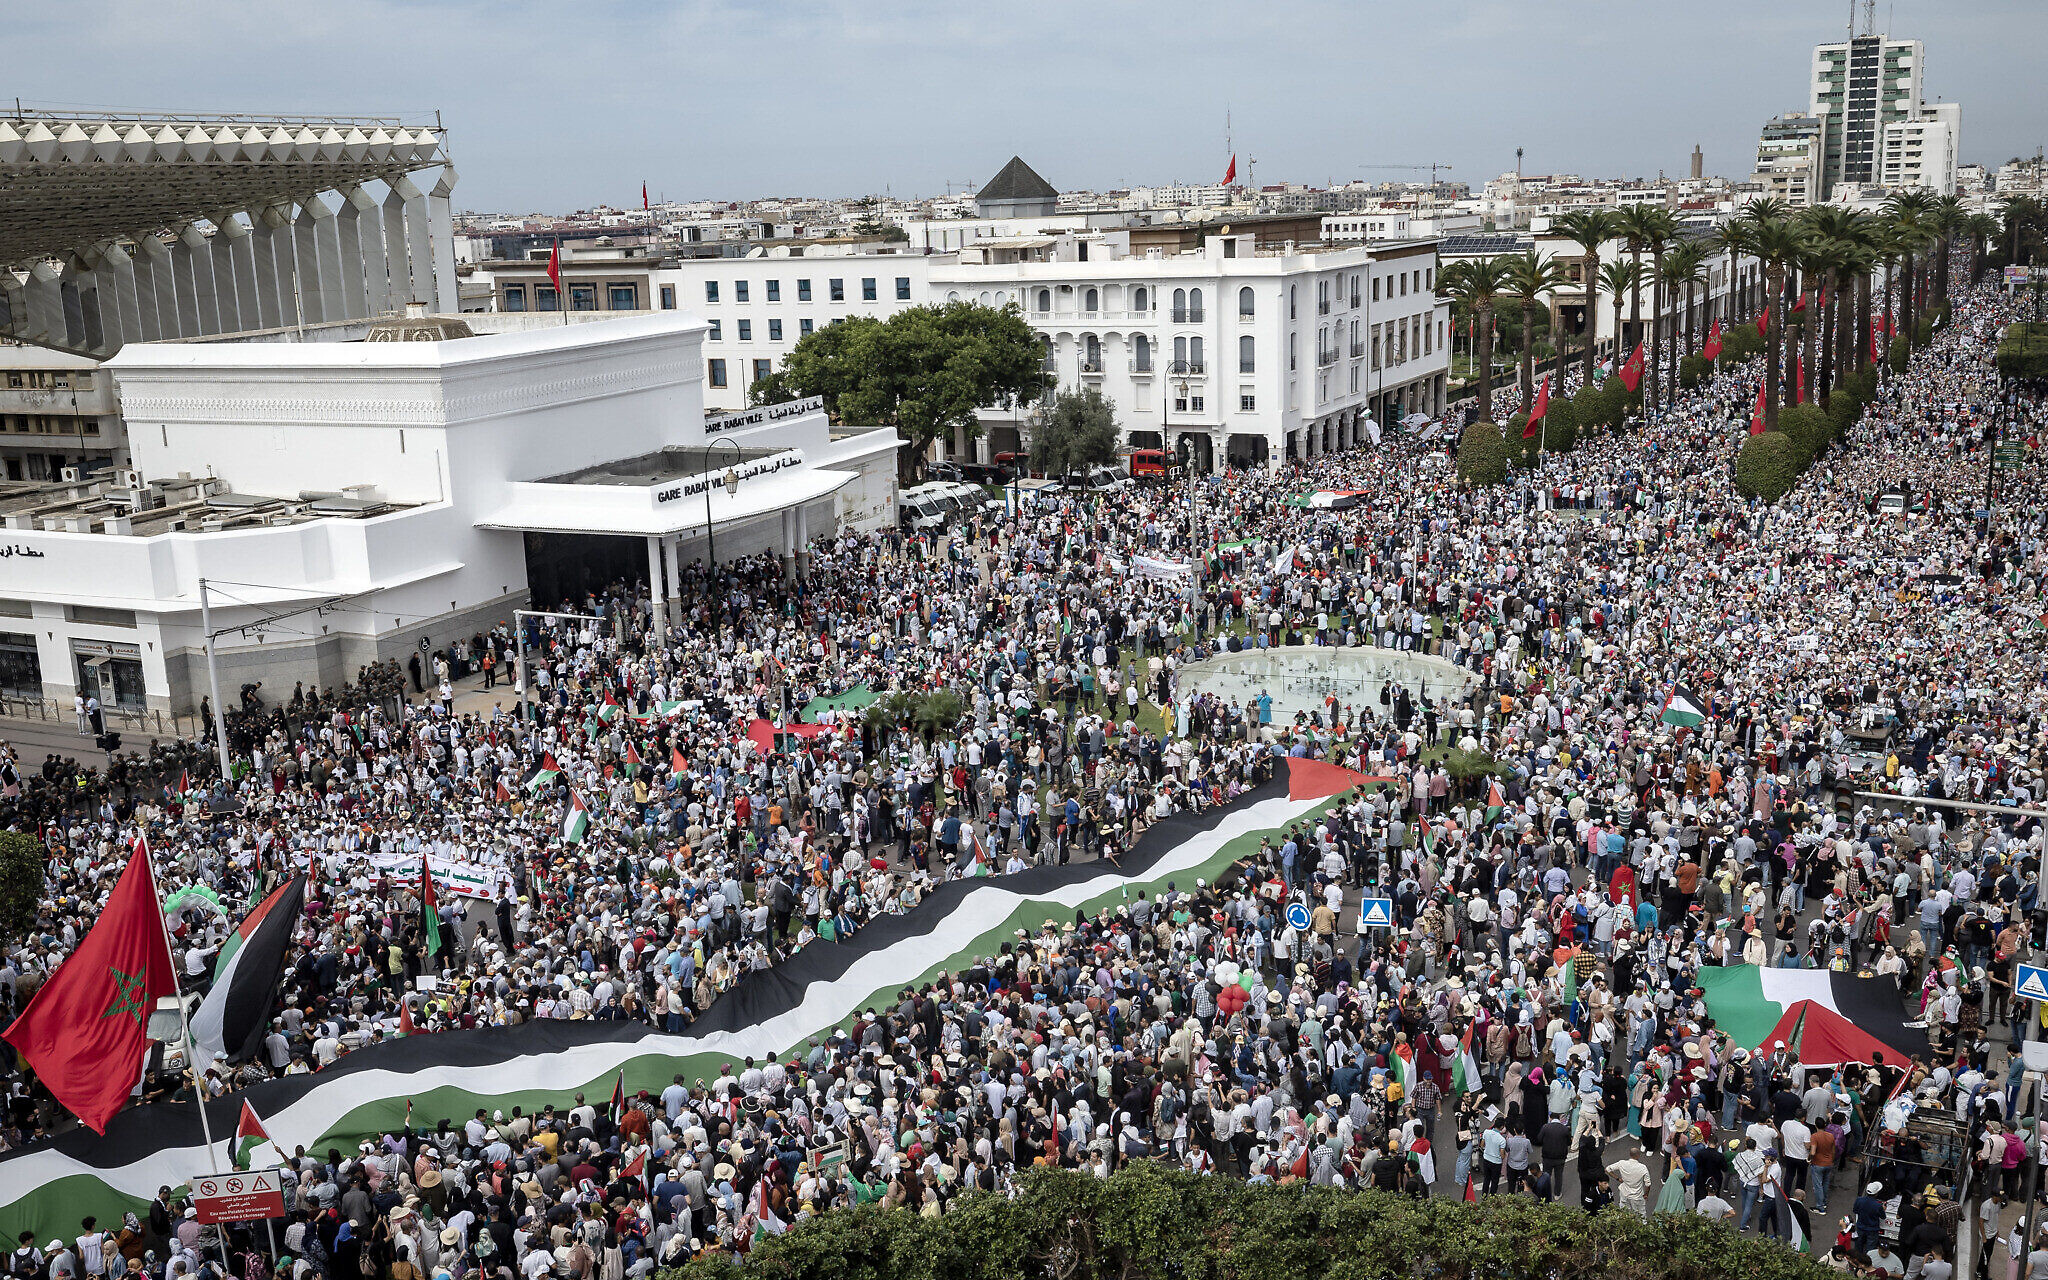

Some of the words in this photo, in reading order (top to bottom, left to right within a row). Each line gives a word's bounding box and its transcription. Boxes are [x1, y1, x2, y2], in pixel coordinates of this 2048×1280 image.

[769, 408, 788, 420] المدينة
[788, 404, 806, 416] الرباط
[724, 417, 746, 430] RABAT
[746, 413, 764, 425] VILLE
[759, 460, 782, 476] الرباط
[782, 457, 803, 469] محطة
[658, 488, 682, 503] GARE
[684, 480, 711, 497] RABAT
[711, 475, 727, 489] VILL
[15, 544, 45, 558] محطة
[398, 866, 450, 879] المربي
[452, 873, 488, 885] الشعب
